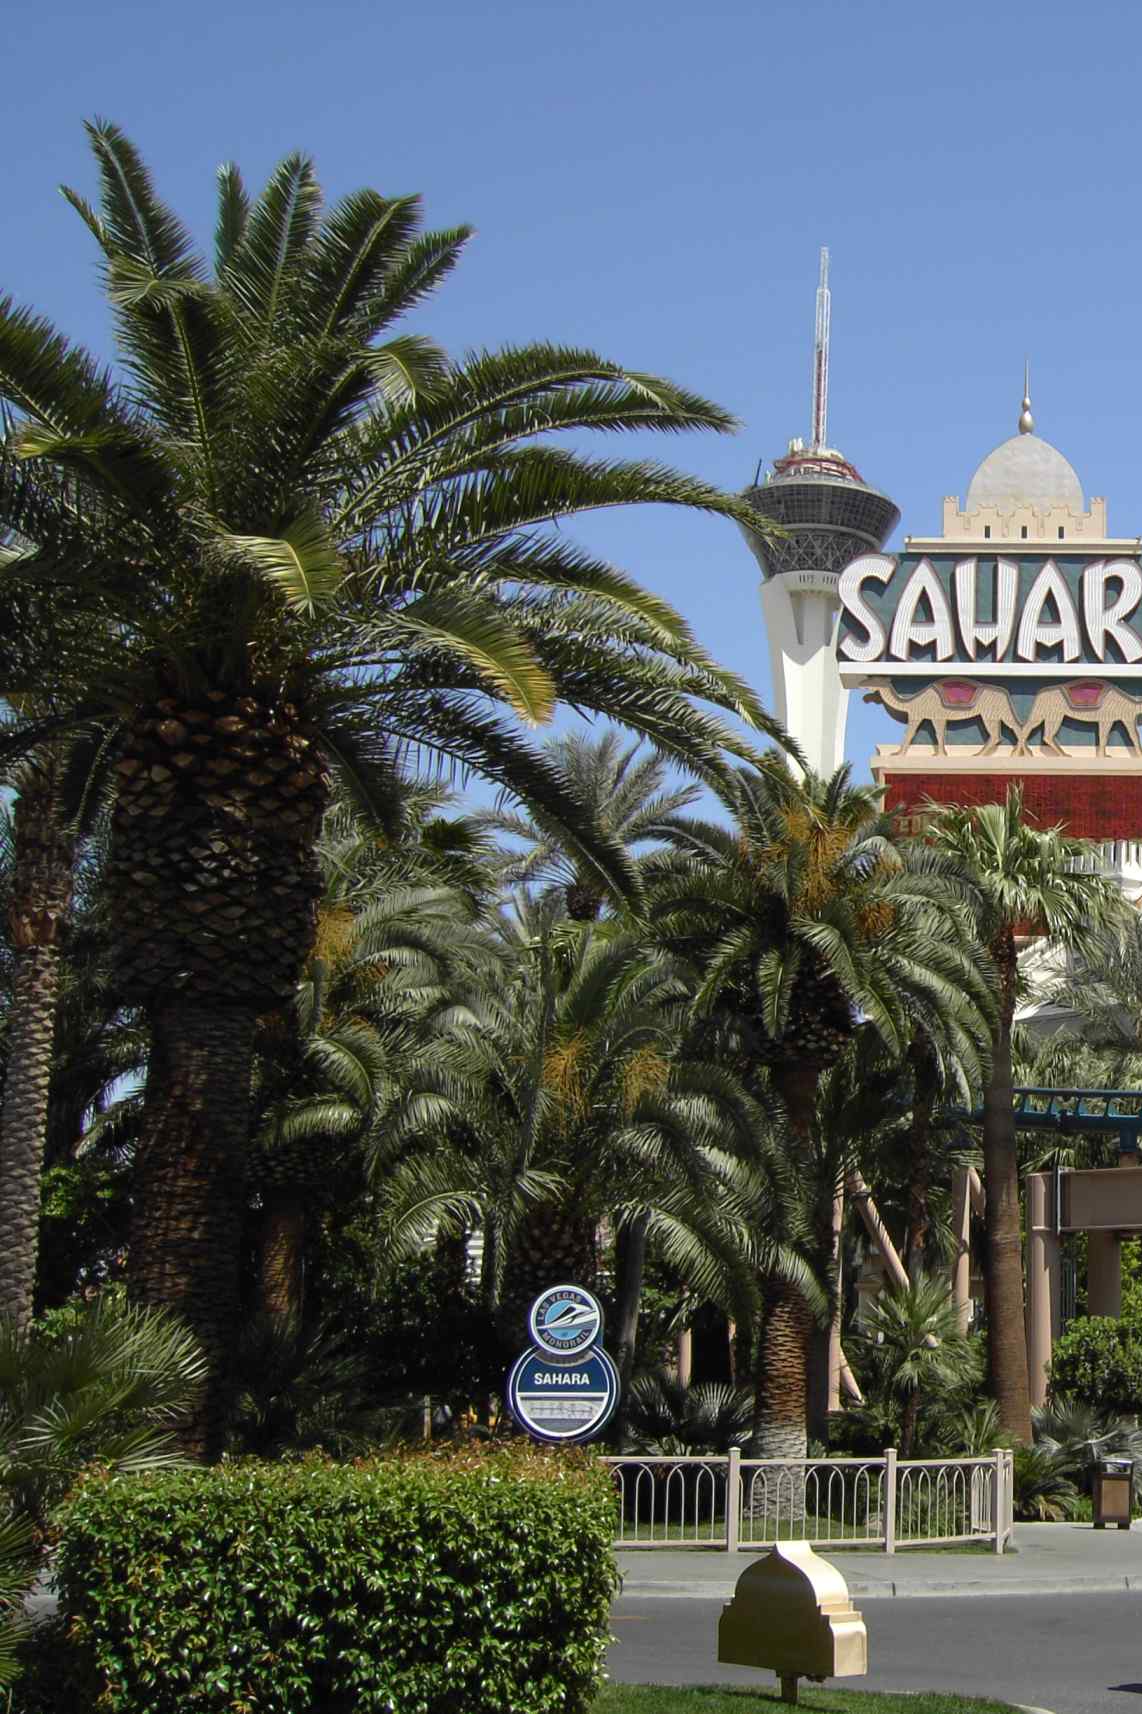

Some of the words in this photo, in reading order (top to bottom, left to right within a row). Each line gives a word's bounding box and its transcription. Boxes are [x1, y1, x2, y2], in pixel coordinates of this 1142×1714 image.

[537, 1302, 550, 1320] LAS
[549, 1292, 582, 1303] VEGAS
[542, 1330, 590, 1348] MONORAIL
[534, 1372, 590, 1385] SAHARA
